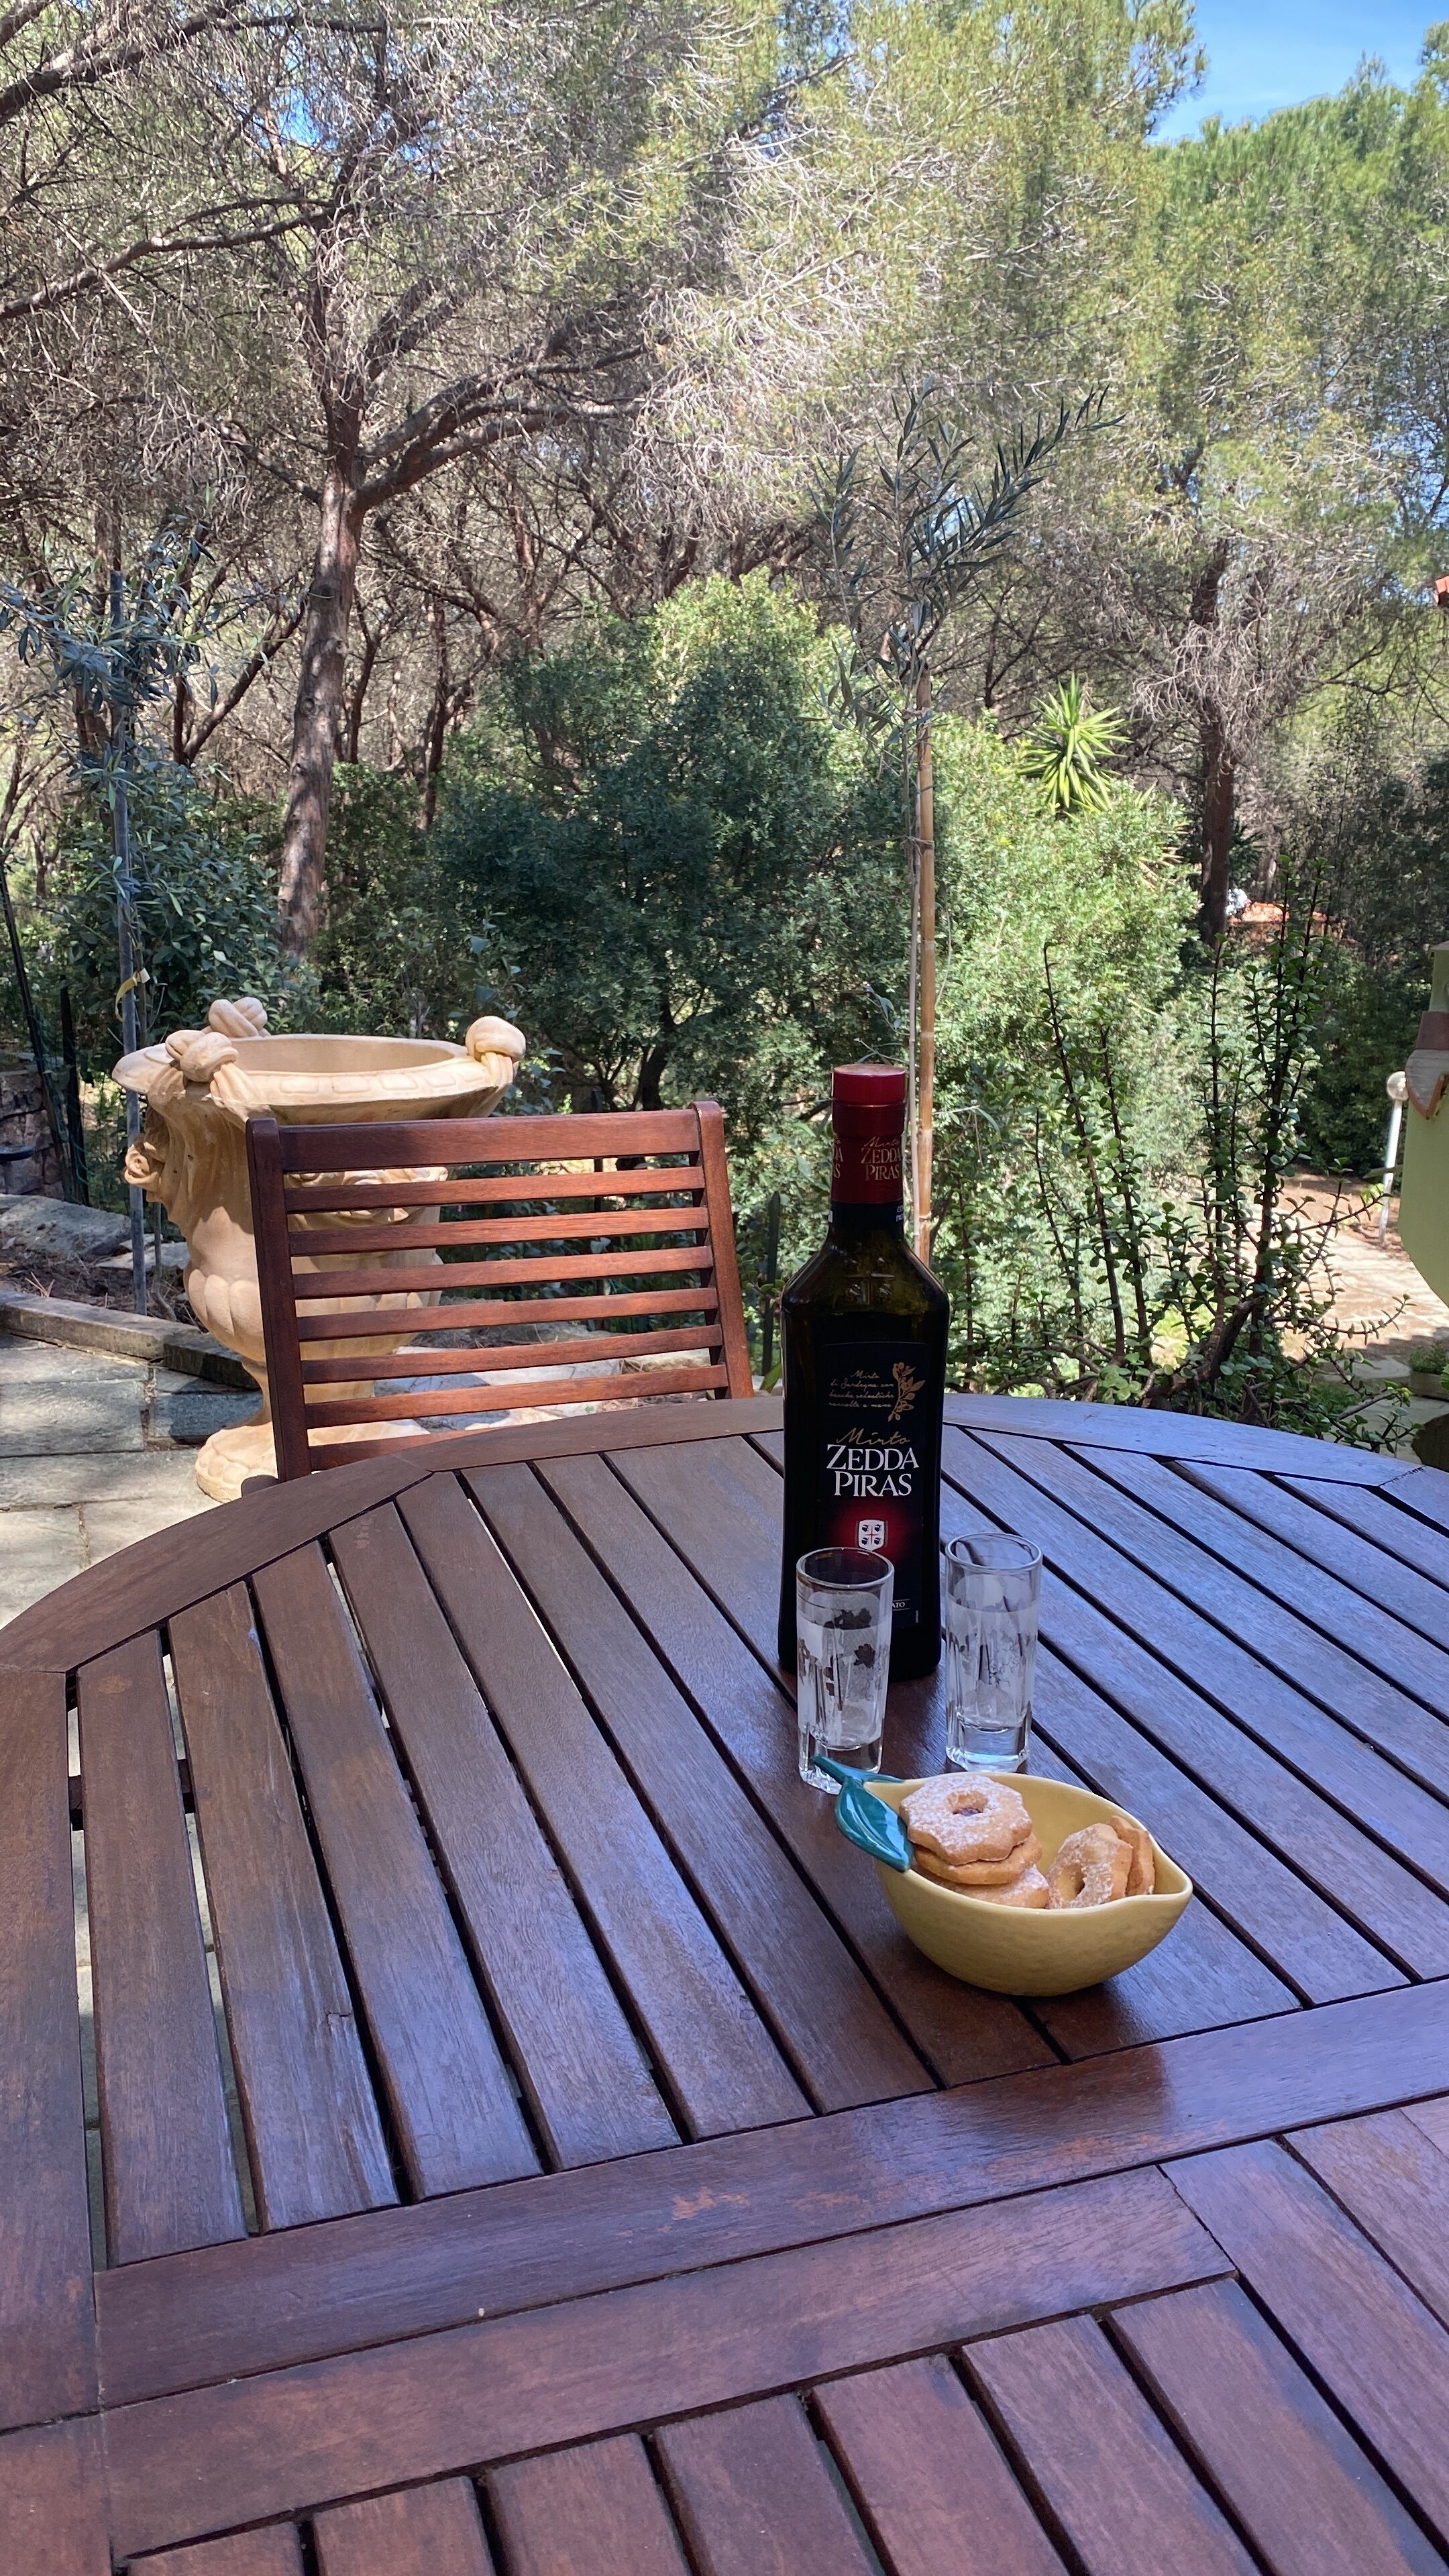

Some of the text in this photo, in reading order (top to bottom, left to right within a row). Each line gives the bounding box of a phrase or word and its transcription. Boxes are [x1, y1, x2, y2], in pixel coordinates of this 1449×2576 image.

[860, 1147, 902, 1164] ZEDDA
[865, 1163, 901, 1181] PIRAS
[836, 1427, 911, 1445] Mirto
[826, 1444, 920, 1470] ZEDDA
[834, 1470, 912, 1497] PIRAS
